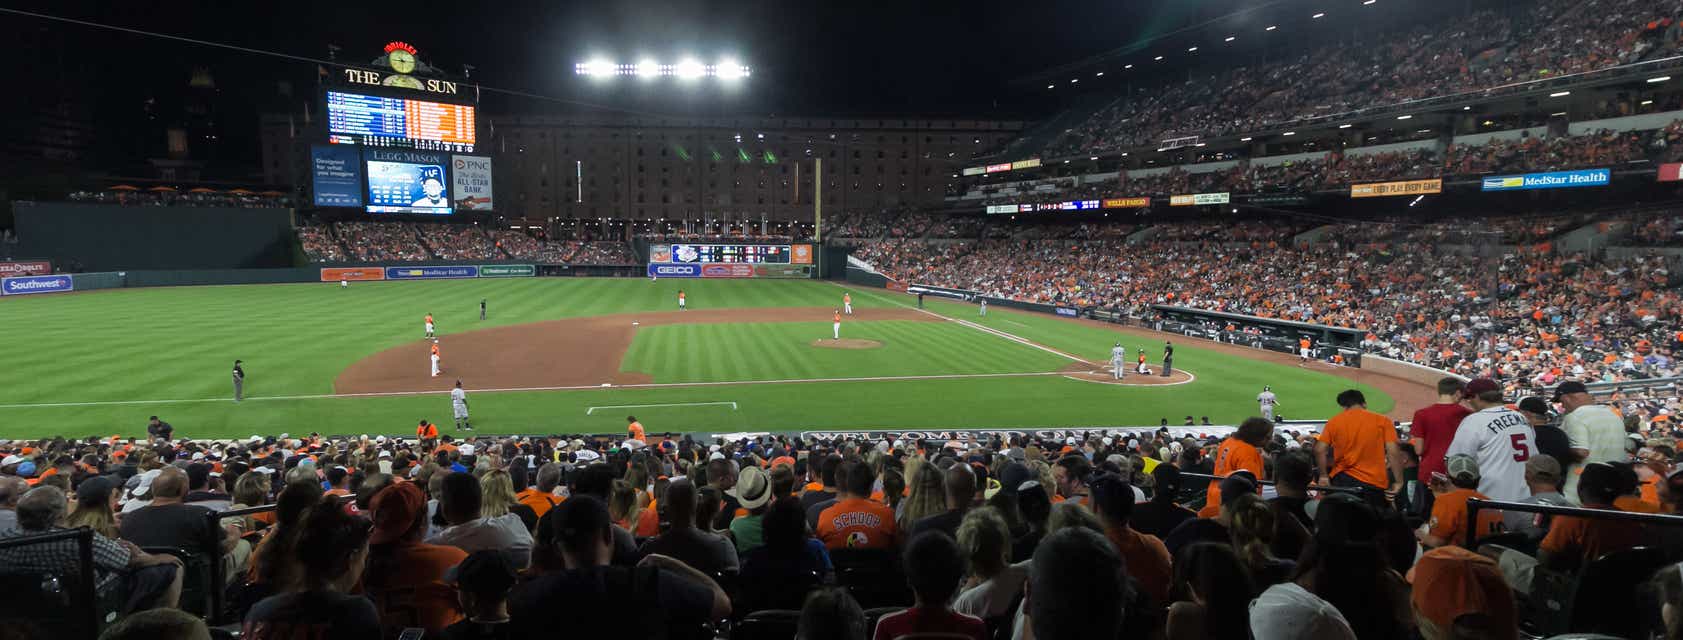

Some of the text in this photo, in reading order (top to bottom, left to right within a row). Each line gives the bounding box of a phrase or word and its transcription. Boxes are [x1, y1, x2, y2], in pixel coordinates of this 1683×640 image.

[384, 41, 417, 55] ORIOLES
[345, 69, 457, 95] THE SUN
[374, 150, 441, 164] LEGG MASON
[467, 160, 489, 170] PNC
[1525, 172, 1607, 186] MedStar Health
[463, 185, 482, 193] BANK
[657, 266, 694, 274] GEICO
[10, 279, 60, 290] Southwest
[1510, 433, 1530, 463] 5
